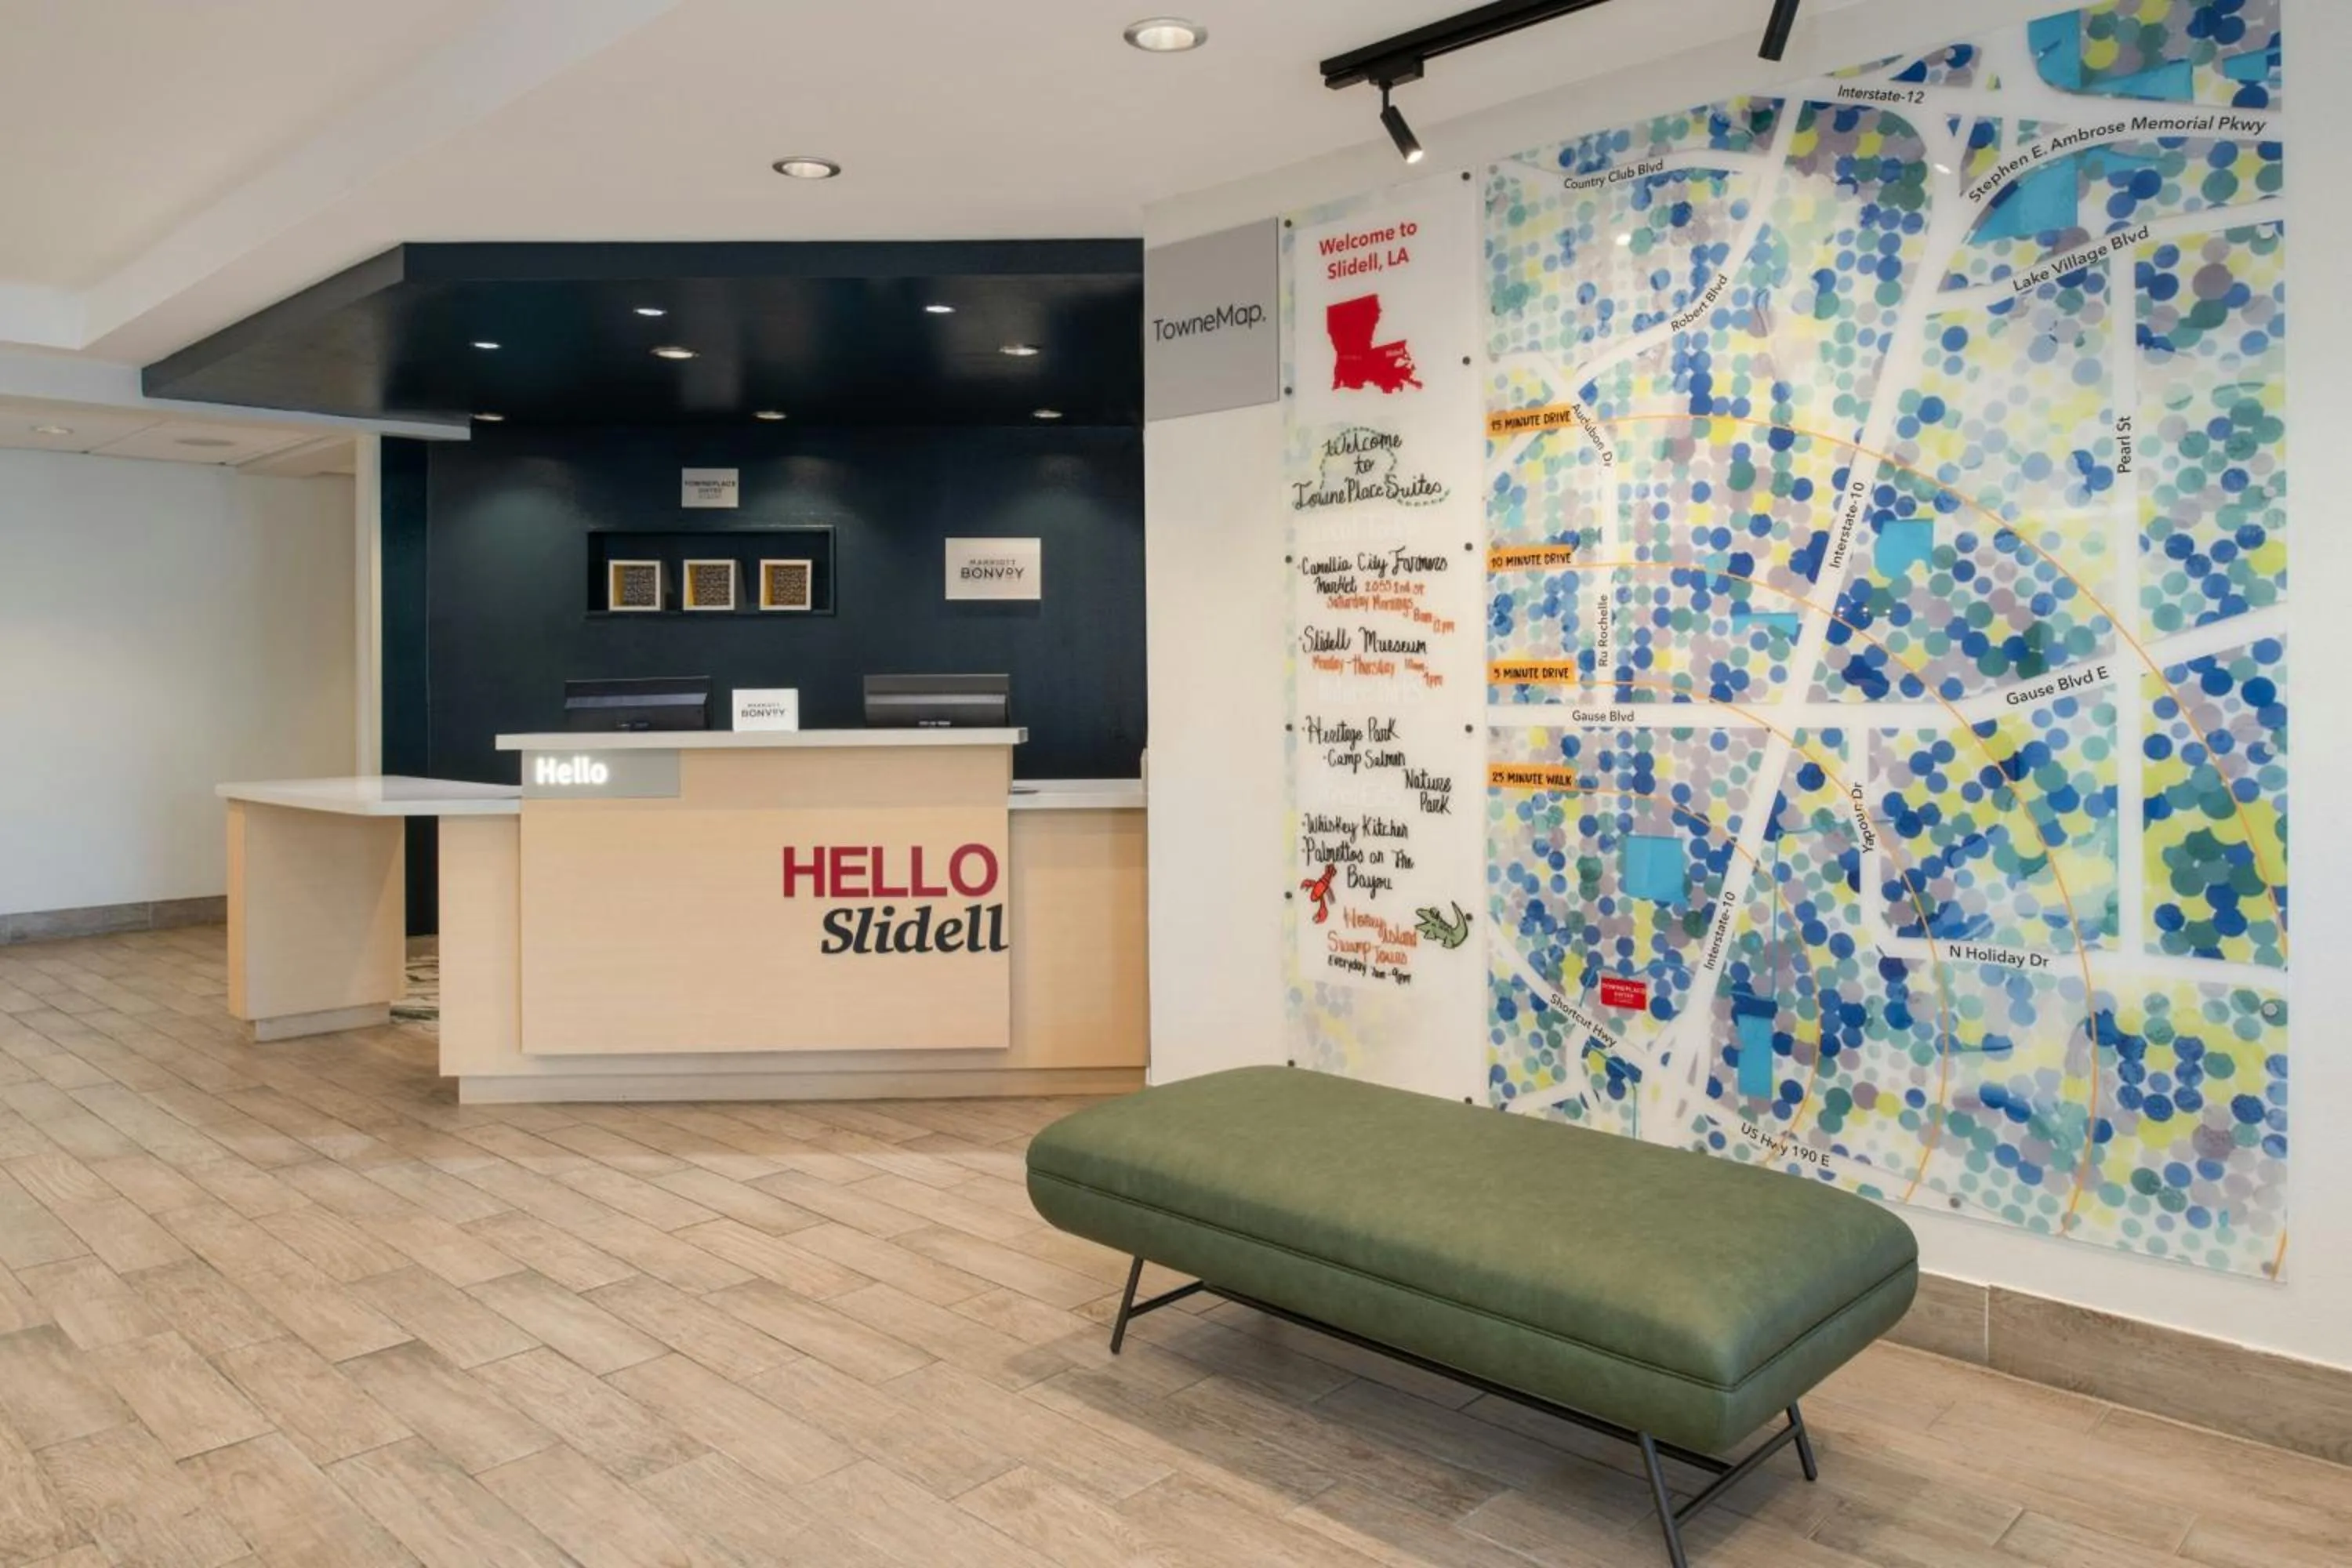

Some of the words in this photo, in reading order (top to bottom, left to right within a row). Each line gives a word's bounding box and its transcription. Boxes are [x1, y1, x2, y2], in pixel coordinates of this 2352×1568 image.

[1838, 85, 1925, 103] Interstate-12
[1969, 154, 2029, 203] Stephen
[2031, 145, 2048, 158] E.
[2050, 122, 2125, 151] Ambrose
[2131, 115, 2214, 130] Memorial
[2218, 115, 2267, 136] Pkwy
[1564, 175, 1606, 190] Country
[1609, 168, 1635, 182] Club
[1638, 159, 1664, 176] Blvd
[1319, 227, 1395, 256] Welcome
[1399, 222, 1417, 237] to
[1327, 252, 1383, 279] Slidell,
[1388, 247, 1410, 267] LA
[2013, 270, 2049, 291] Lake
[2050, 245, 2108, 274] Village
[2111, 226, 2150, 250] Blvd
[1671, 301, 1708, 332] Robert
[1705, 273, 1728, 302] Blvd
[1153, 303, 1266, 342] TowneMap.
[1491, 420, 1502, 431] 15
[1504, 414, 1541, 430] MINUTE
[1544, 410, 1572, 425] DRIVE
[2116, 416, 2132, 432] St
[1322, 433, 1402, 456] Welcome
[2116, 435, 2132, 474] Pearl
[1354, 455, 1375, 474] to
[1829, 481, 1865, 568] Interstate-10
[960, 567, 1025, 579] BONVOY
[1357, 552, 1388, 578] City
[1491, 557, 1503, 568] 10
[1506, 554, 1541, 567] MINUTE
[1544, 553, 1572, 564] DRIVE
[1597, 593, 1609, 648] Rochelle
[1302, 625, 1351, 653] Slidell
[1493, 669, 1500, 678] 5
[1504, 668, 1539, 679] MINUTE
[1542, 667, 1569, 679] DRIVE
[1597, 651, 1608, 667] Ru
[2006, 684, 2055, 705] Gause
[2057, 669, 2094, 691] Blvd
[2096, 666, 2110, 680] E
[1368, 716, 1400, 744] Park
[1572, 710, 1606, 722] Gause
[1610, 710, 1635, 722] Blvd
[535, 756, 609, 786] Hello
[1327, 749, 1362, 775] Camp
[1492, 771, 1504, 782] 25
[1507, 772, 1544, 785] MINUTE
[1546, 774, 1572, 787] WALK
[1851, 782, 1863, 799] Dr
[1420, 791, 1451, 814] Park
[1305, 812, 1359, 844] Whiskey
[1362, 814, 1409, 838] Kitchen
[782, 844, 998, 898] HELLO
[1370, 851, 1384, 864] on
[1347, 864, 1392, 899] Bayou
[821, 904, 1009, 955] Slidell
[1703, 891, 1736, 970] Interstate-10
[1949, 945, 1961, 958] N
[1966, 946, 2025, 968] Holiday
[2030, 953, 2049, 967] Dr
[1550, 993, 1592, 1029] Shortcut
[1592, 1024, 1617, 1047] Hwy
[1741, 1122, 1758, 1139] US
[1760, 1134, 1788, 1156] Hwy
[1792, 1145, 1817, 1163] 190
[1821, 1154, 1830, 1167] E
